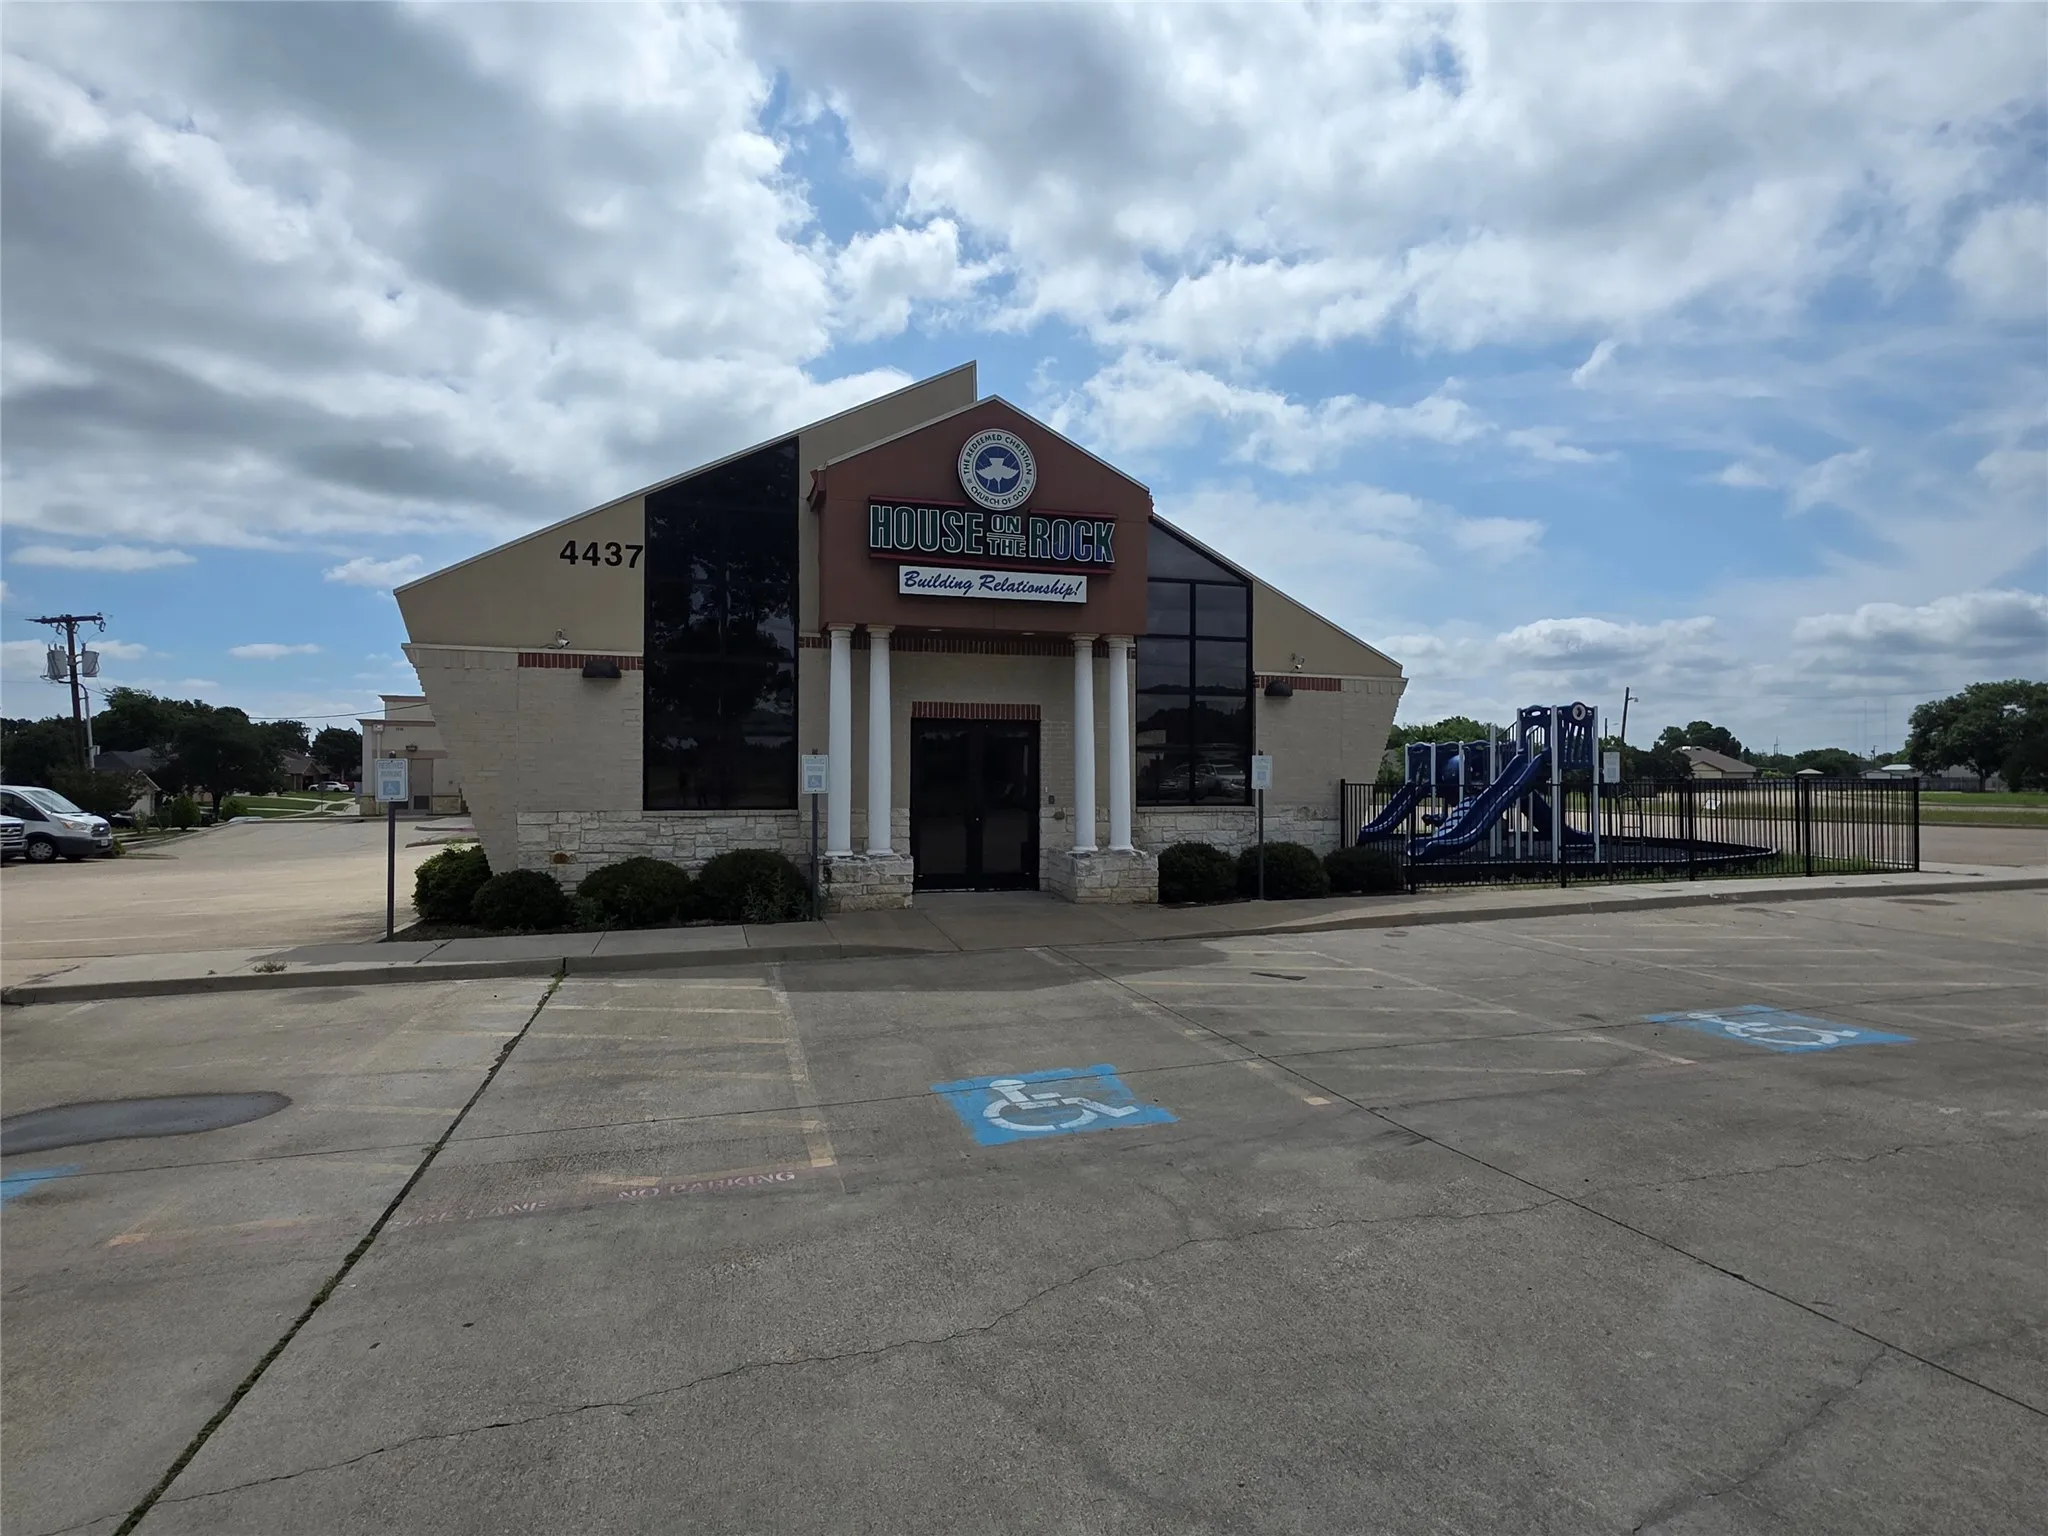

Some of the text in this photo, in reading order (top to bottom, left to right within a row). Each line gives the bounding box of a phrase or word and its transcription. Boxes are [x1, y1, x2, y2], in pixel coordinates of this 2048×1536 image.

[966, 434, 1002, 458] REDEEMED
[1005, 437, 1032, 475] CHRISTIAN
[971, 486, 1027, 505] CHURCH OF GOD
[870, 505, 1116, 563] HOUSE ON THE ROCK
[559, 540, 644, 568] 4437
[904, 570, 1082, 599] Building Relationship!
[618, 1187, 660, 1200] NO
[670, 1171, 796, 1194] PARKING
